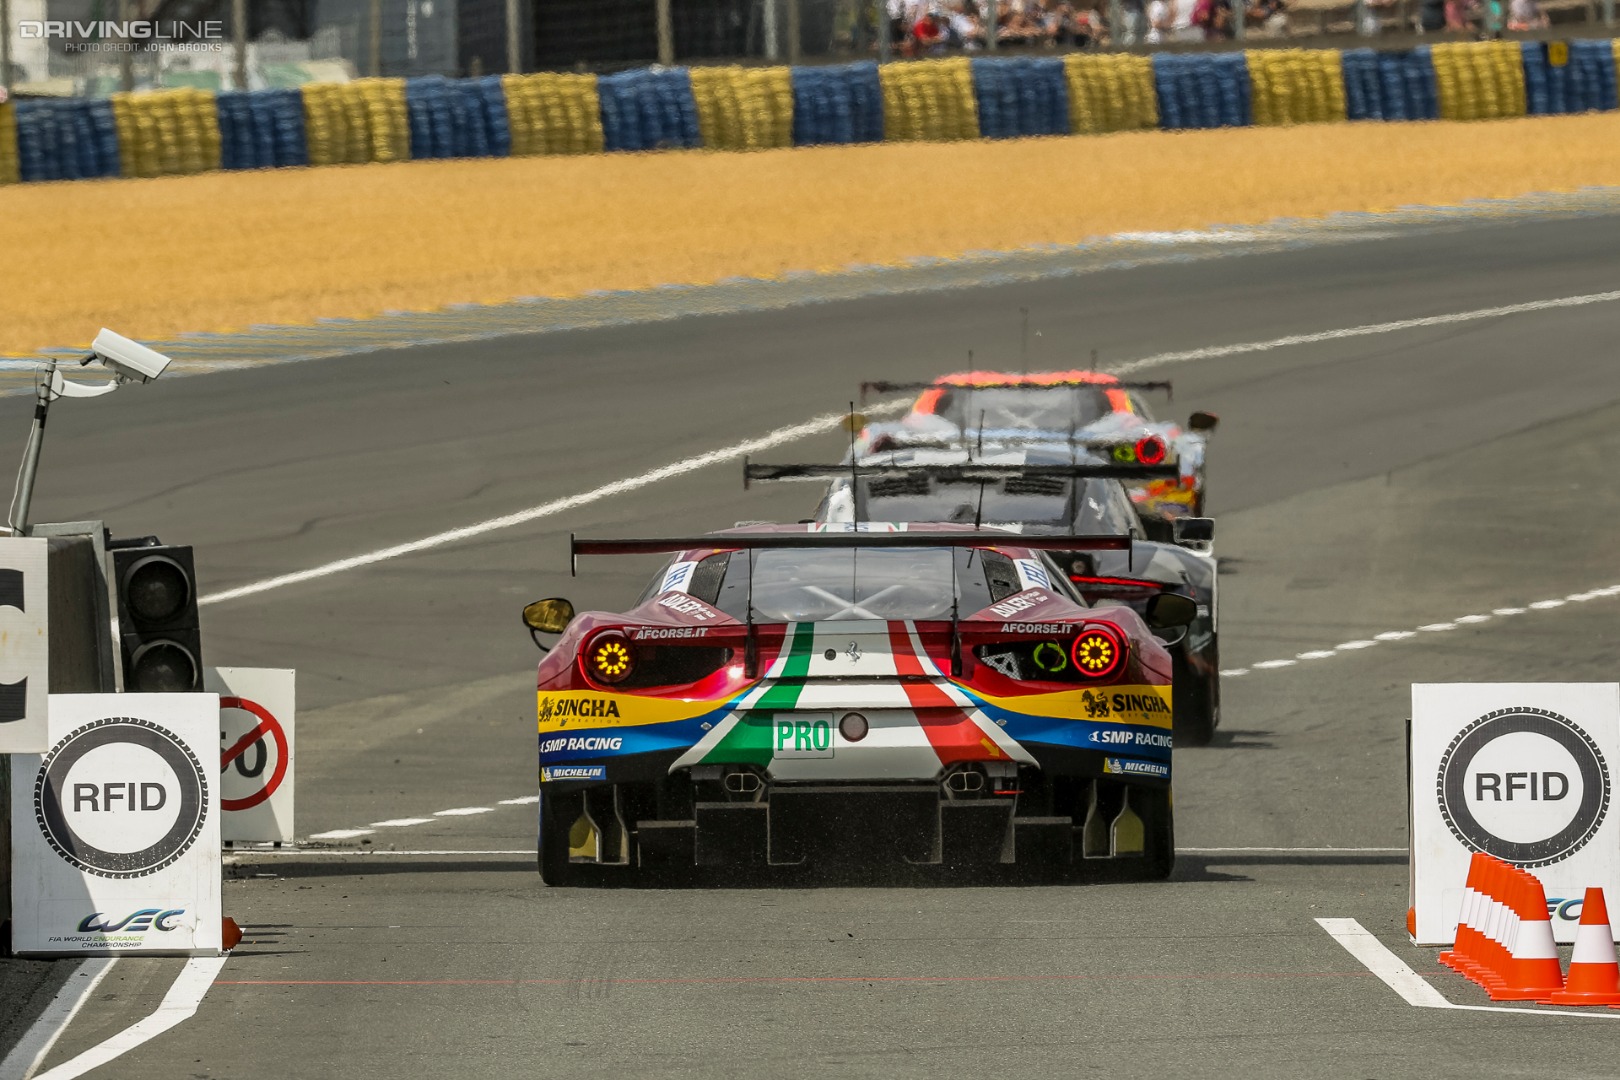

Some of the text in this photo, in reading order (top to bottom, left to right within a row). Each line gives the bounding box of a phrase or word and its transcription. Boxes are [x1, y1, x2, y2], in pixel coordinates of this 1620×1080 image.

[635, 627, 708, 640] AFCORSE.IT
[1001, 623, 1073, 634] AFCORSE.IT
[554, 699, 620, 718] SINGHA
[1112, 693, 1172, 714] SINGHA
[777, 720, 830, 751] PRO
[1101, 730, 1172, 748] SMP RACING
[545, 737, 622, 753] SMP RACING
[553, 768, 602, 777] MICHELIN
[1124, 762, 1168, 775] MICHELIN
[1476, 771, 1569, 801] RFID
[73, 782, 167, 812] RFID
[77, 908, 186, 933] WEC
